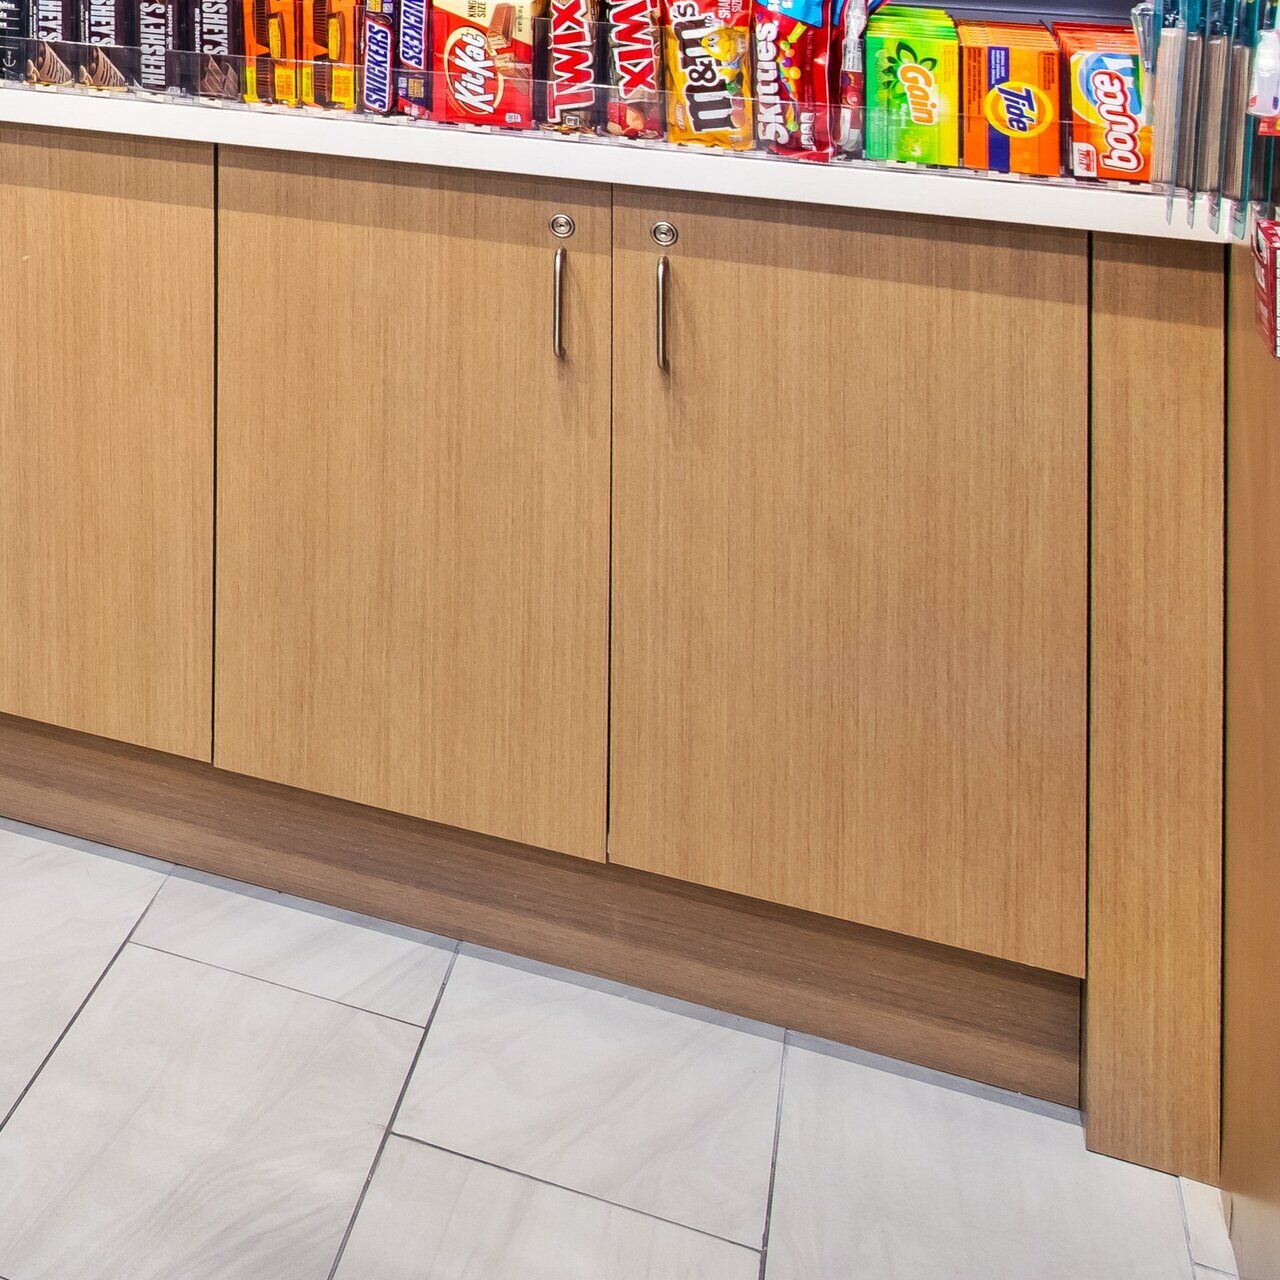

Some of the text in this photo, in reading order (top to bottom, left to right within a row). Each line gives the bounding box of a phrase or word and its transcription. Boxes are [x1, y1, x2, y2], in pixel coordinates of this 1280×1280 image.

[468, 0, 477, 18] KING
[477, 0, 487, 17] SIZE
[140, 1, 166, 87] HERSHEY'S
[365, 22, 390, 112] SNICKERS
[899, 64, 937, 126] Gain
[997, 86, 1037, 132] Tide
[1101, 71, 1144, 171] bounce
